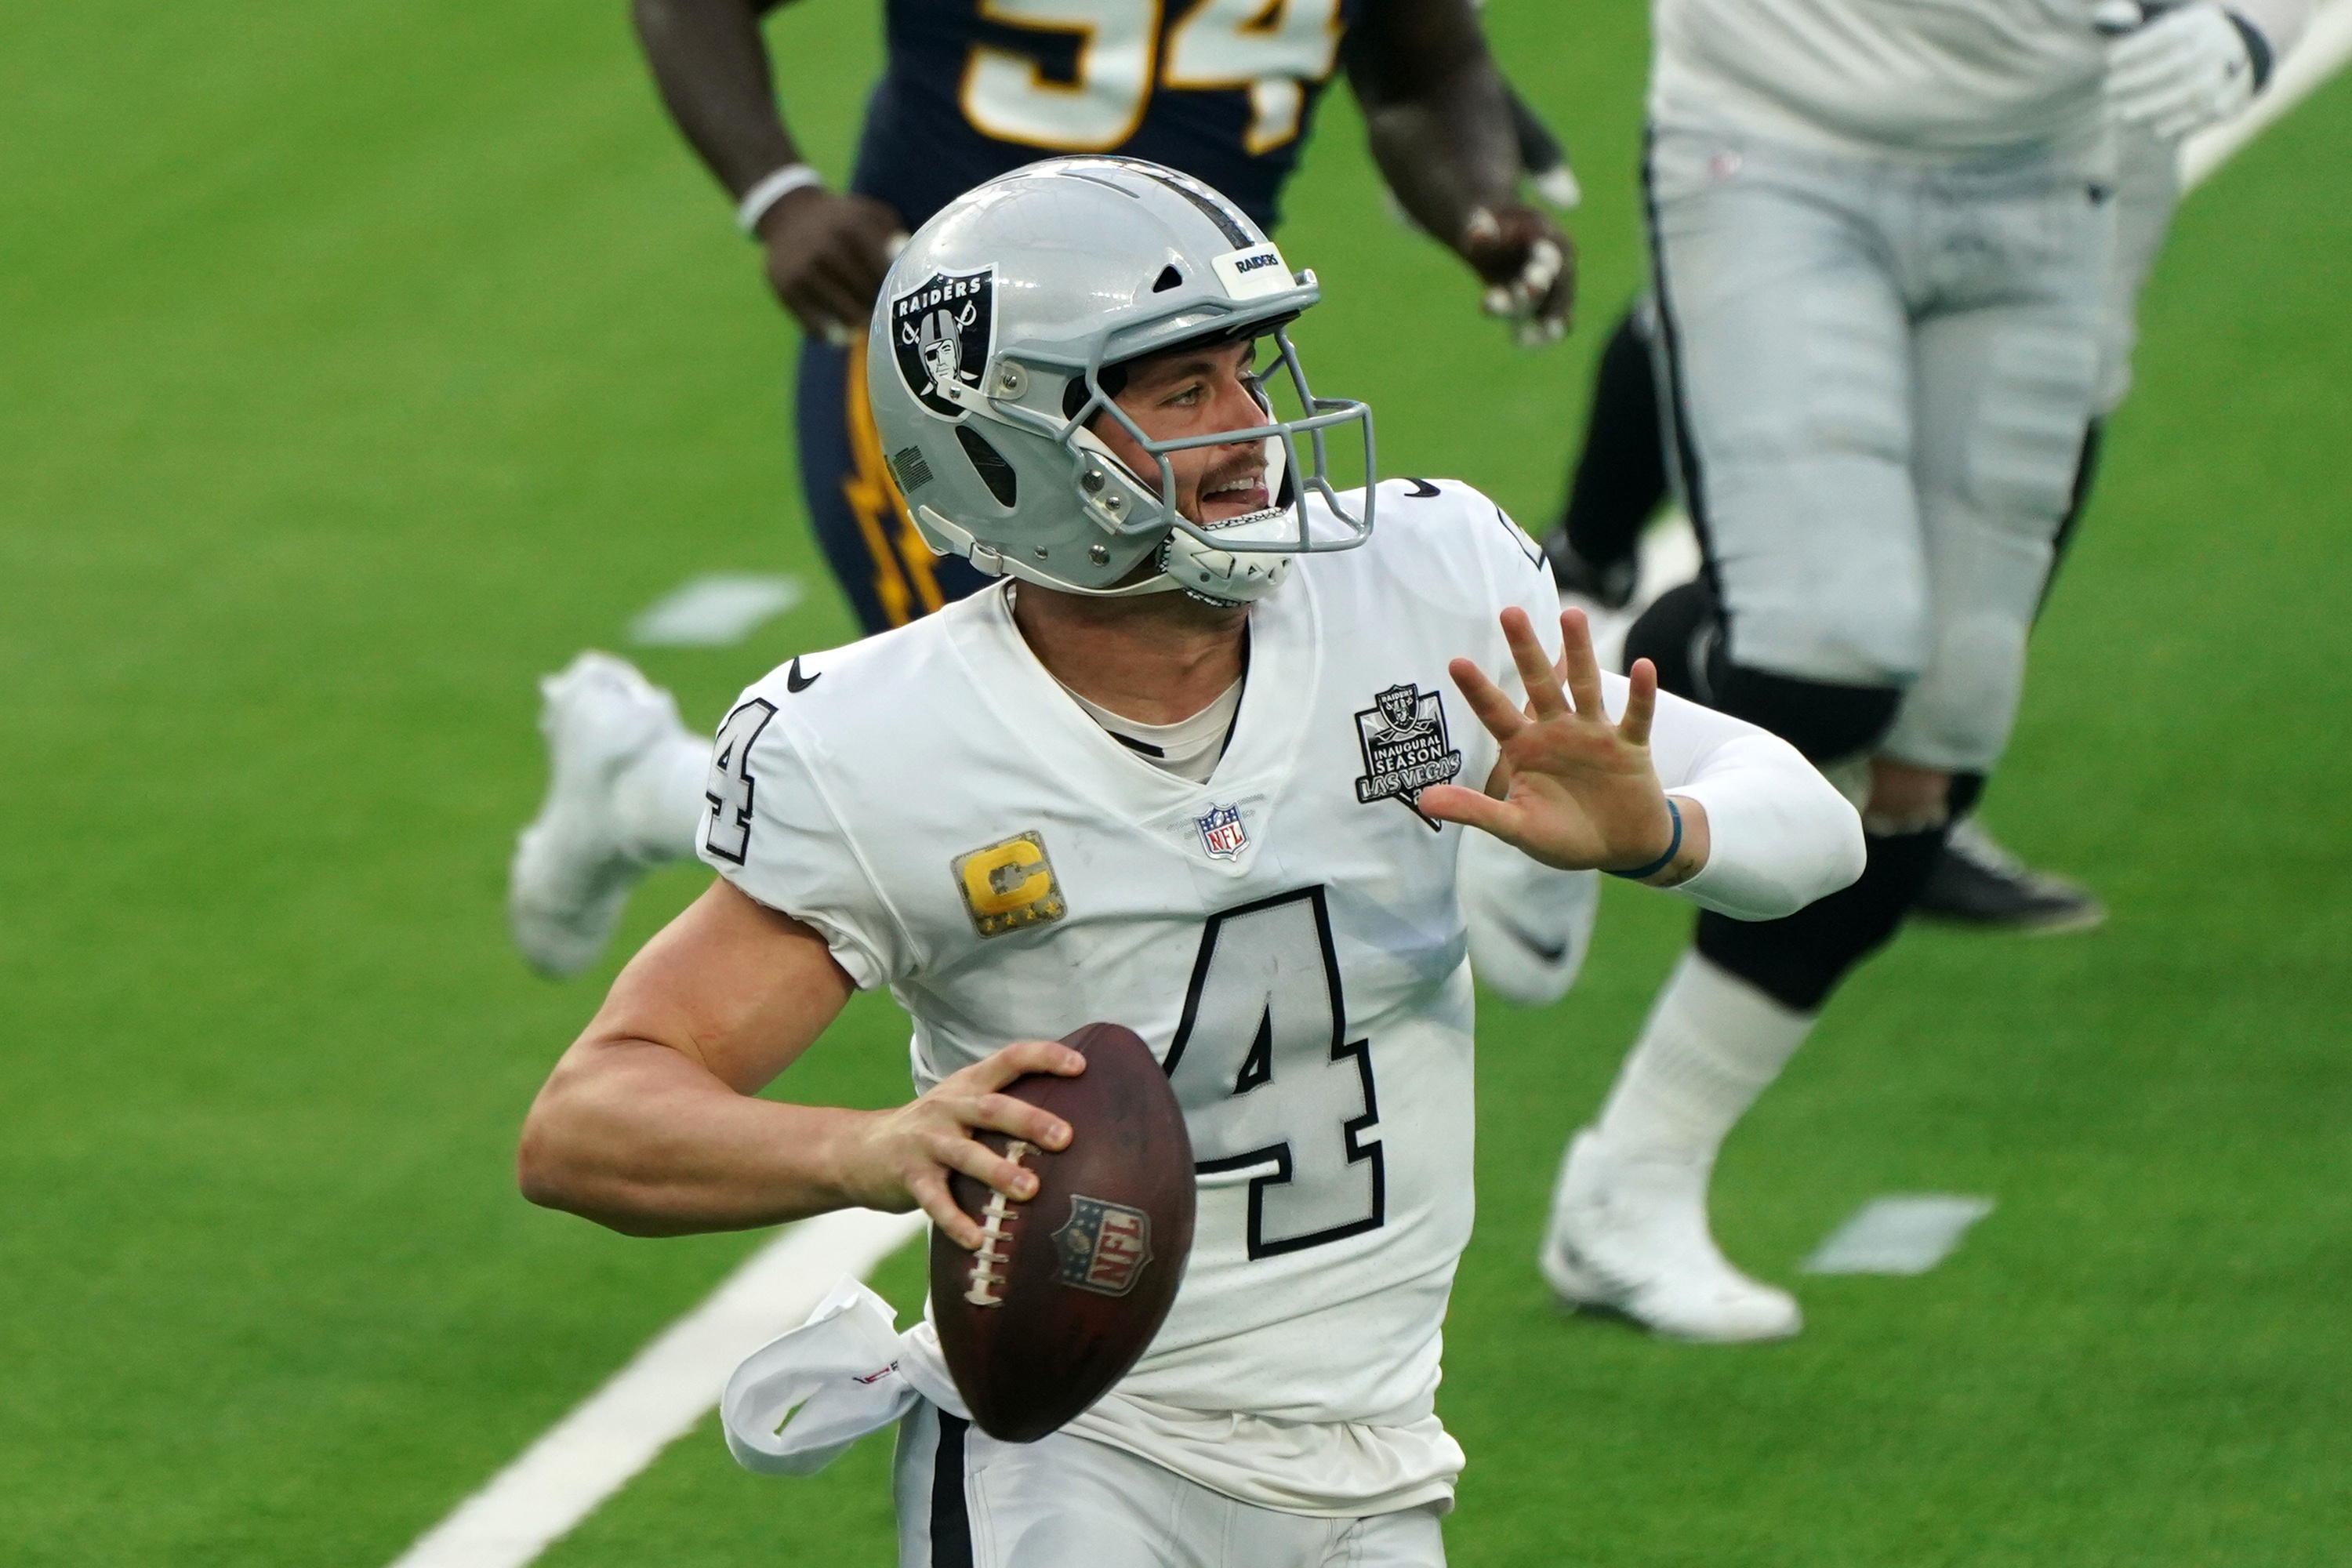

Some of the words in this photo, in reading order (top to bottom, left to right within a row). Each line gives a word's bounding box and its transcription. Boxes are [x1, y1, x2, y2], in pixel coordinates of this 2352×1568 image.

[1235, 254, 1279, 273] RAIDERS
[899, 277, 981, 317] RAIDERS
[1381, 689, 1414, 702] RAIDERS
[1374, 735, 1441, 760] INAUGURAL
[1376, 745, 1442, 774] SEASON
[706, 697, 779, 866] 4
[1360, 771, 1401, 800] LAS
[1399, 753, 1460, 789] VEGAS
[1207, 825, 1243, 851] NFL
[963, 840, 1050, 916] C
[1162, 884, 1385, 1261] 4
[1091, 1219, 1142, 1284] NFL
